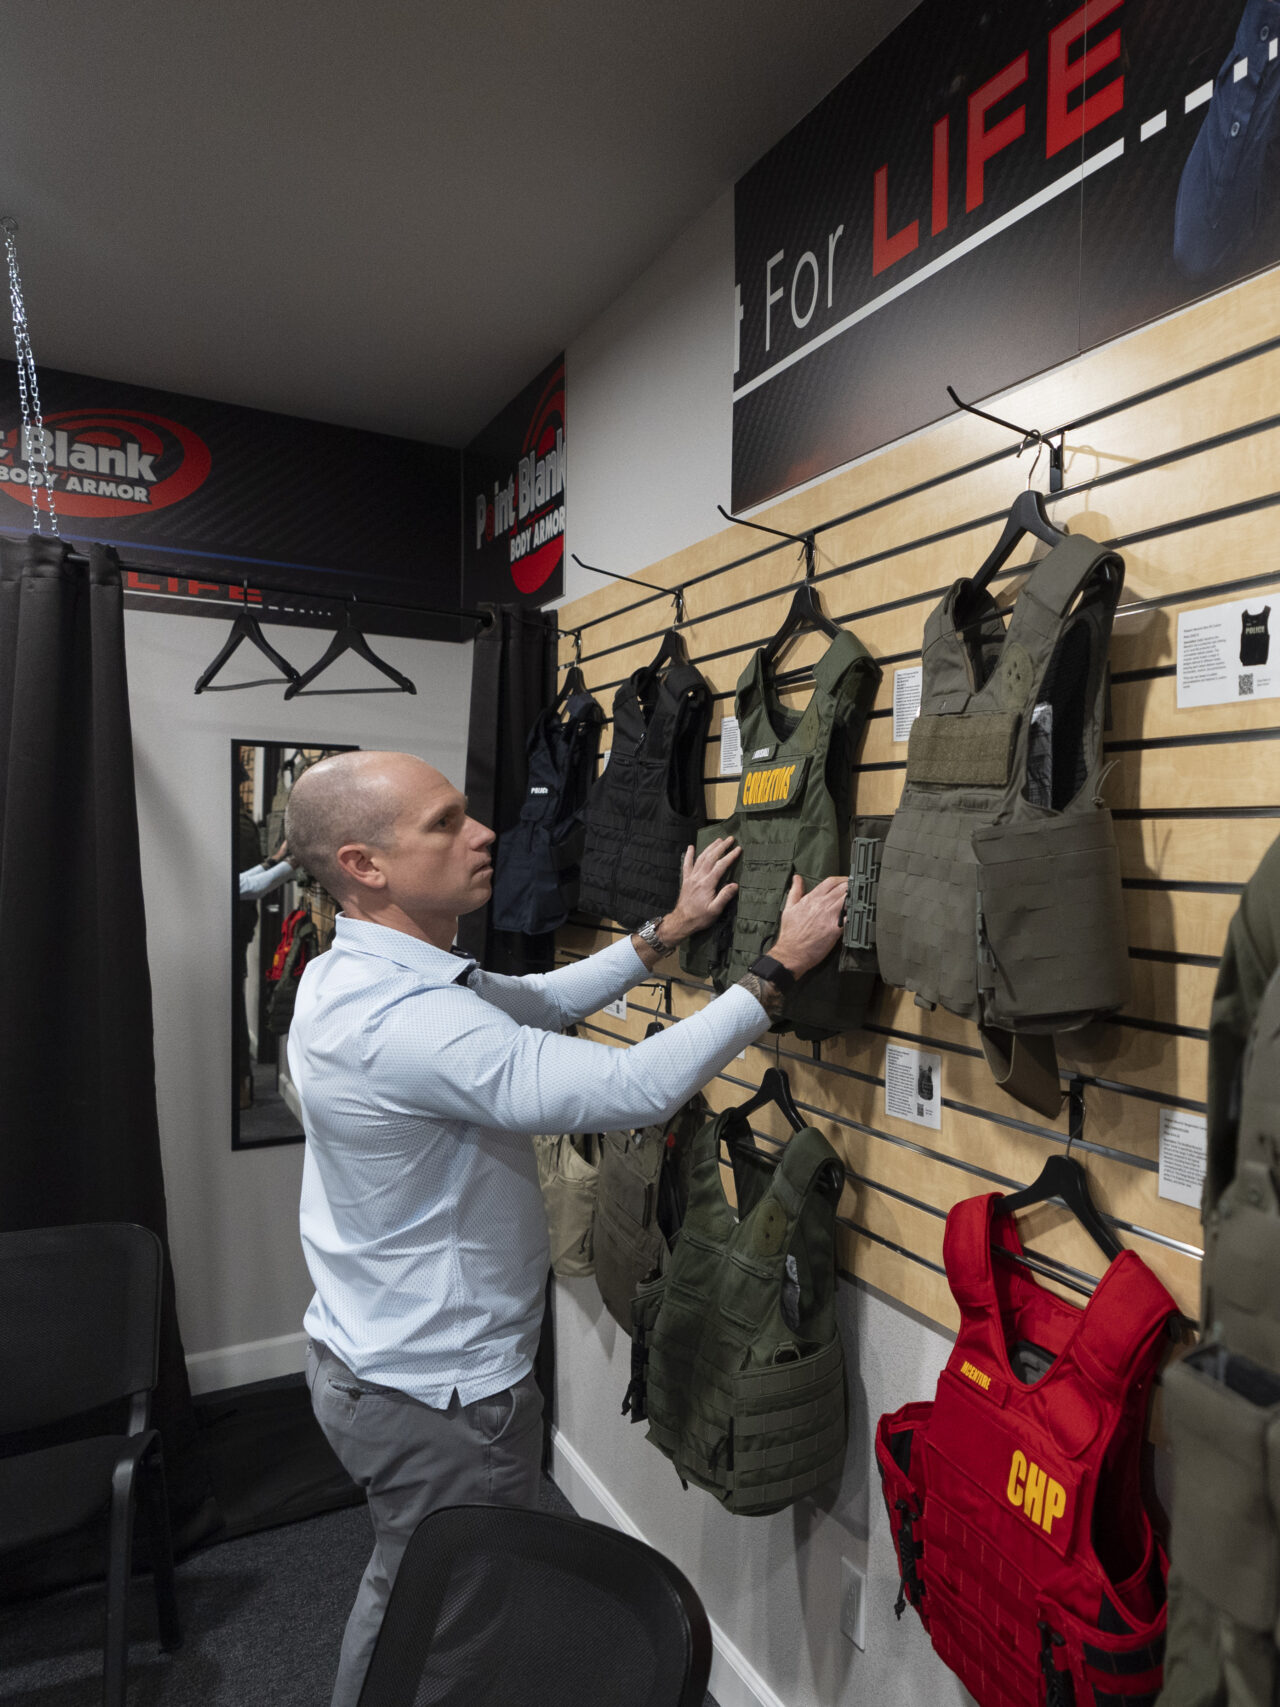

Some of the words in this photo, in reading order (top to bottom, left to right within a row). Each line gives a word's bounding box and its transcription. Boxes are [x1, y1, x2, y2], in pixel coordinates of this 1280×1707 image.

[765, 224, 844, 352] For
[872, 0, 1124, 277] LIFE
[21, 424, 158, 482] Blank
[65, 476, 149, 502] ARMOR
[476, 472, 516, 550] Point
[518, 427, 566, 521] Blank
[510, 527, 532, 562] BODY
[533, 505, 565, 548] ARMOR
[1006, 1449, 1067, 1535] CHP
